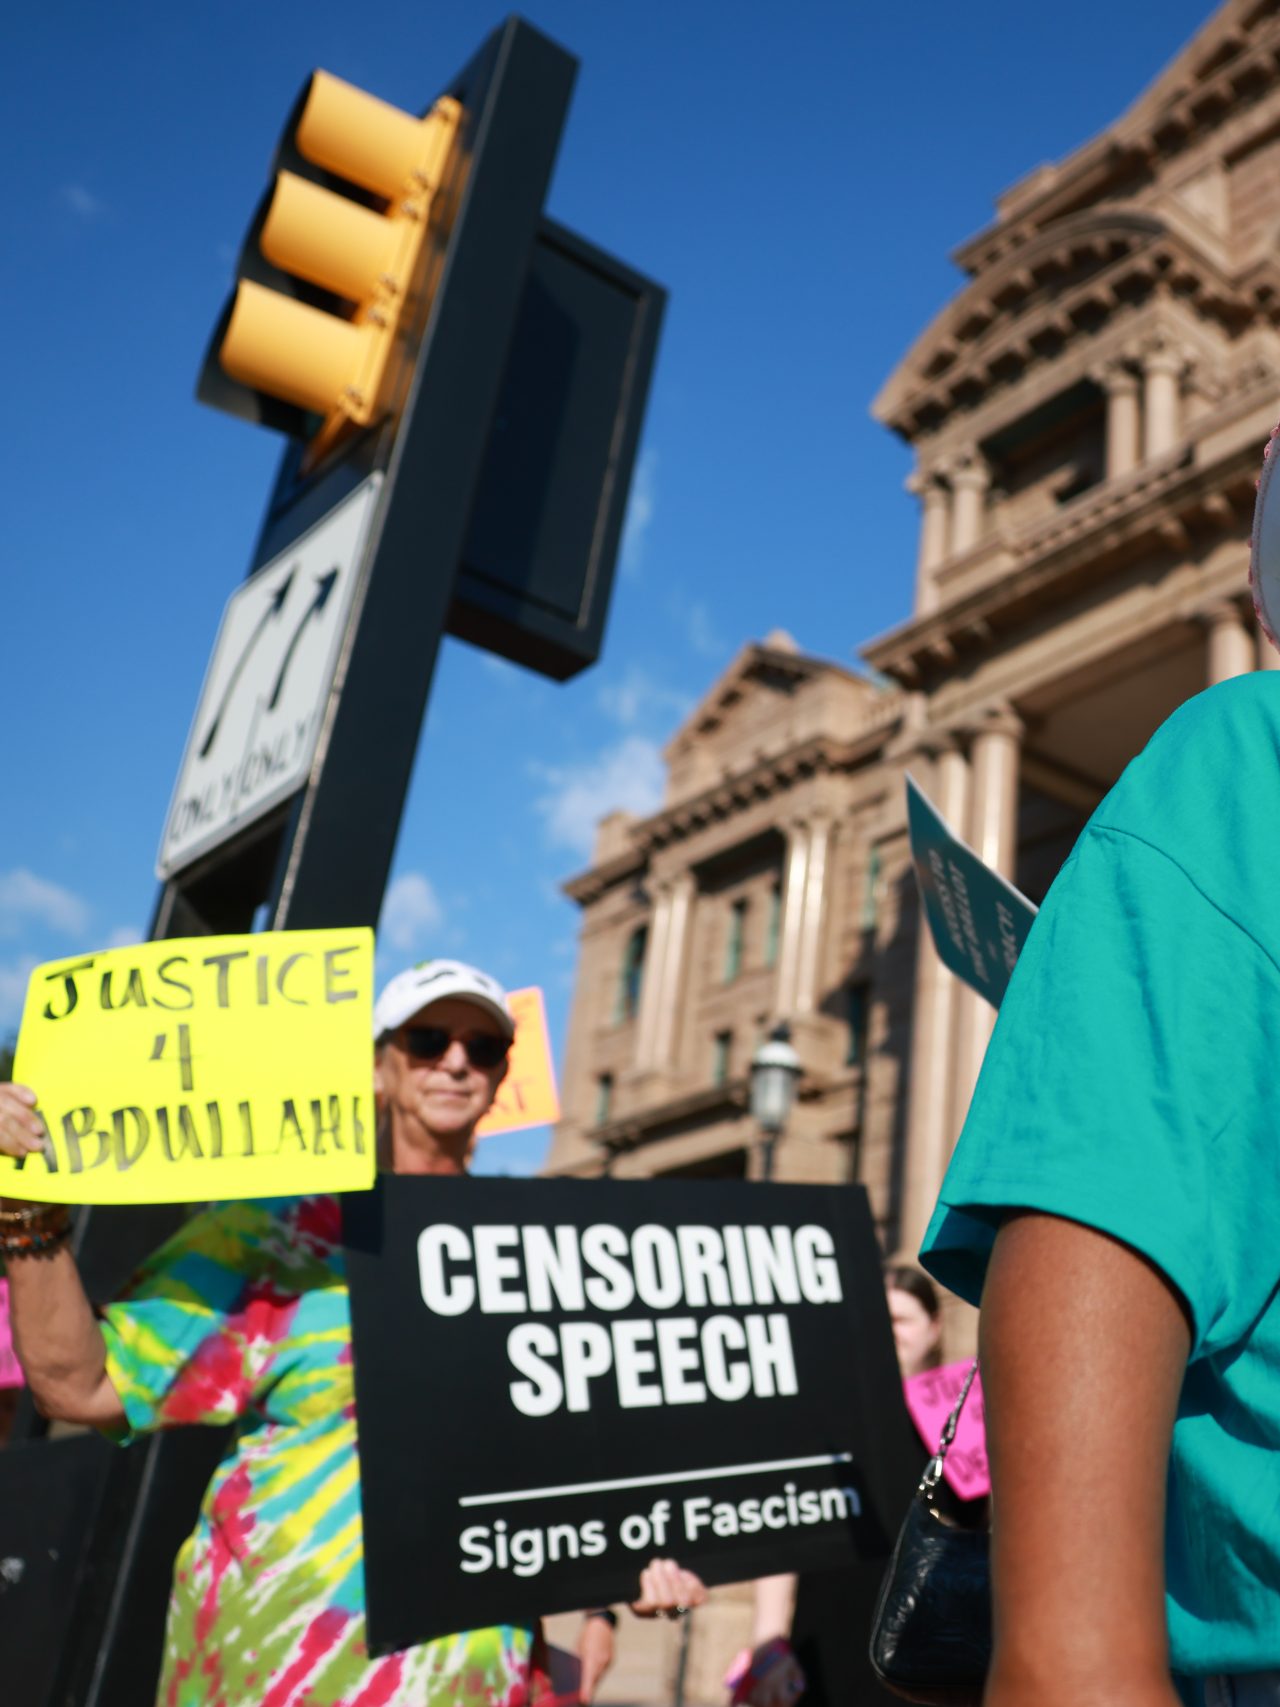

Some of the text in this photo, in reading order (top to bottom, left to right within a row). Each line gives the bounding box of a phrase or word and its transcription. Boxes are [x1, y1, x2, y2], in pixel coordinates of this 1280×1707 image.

[43, 946, 360, 1020] JUSTICE
[150, 1024, 194, 1091] 4
[416, 1223, 844, 1317] CENSORING
[506, 1313, 799, 1417] SPEECH
[458, 1482, 862, 1577] Signs of Fascism
